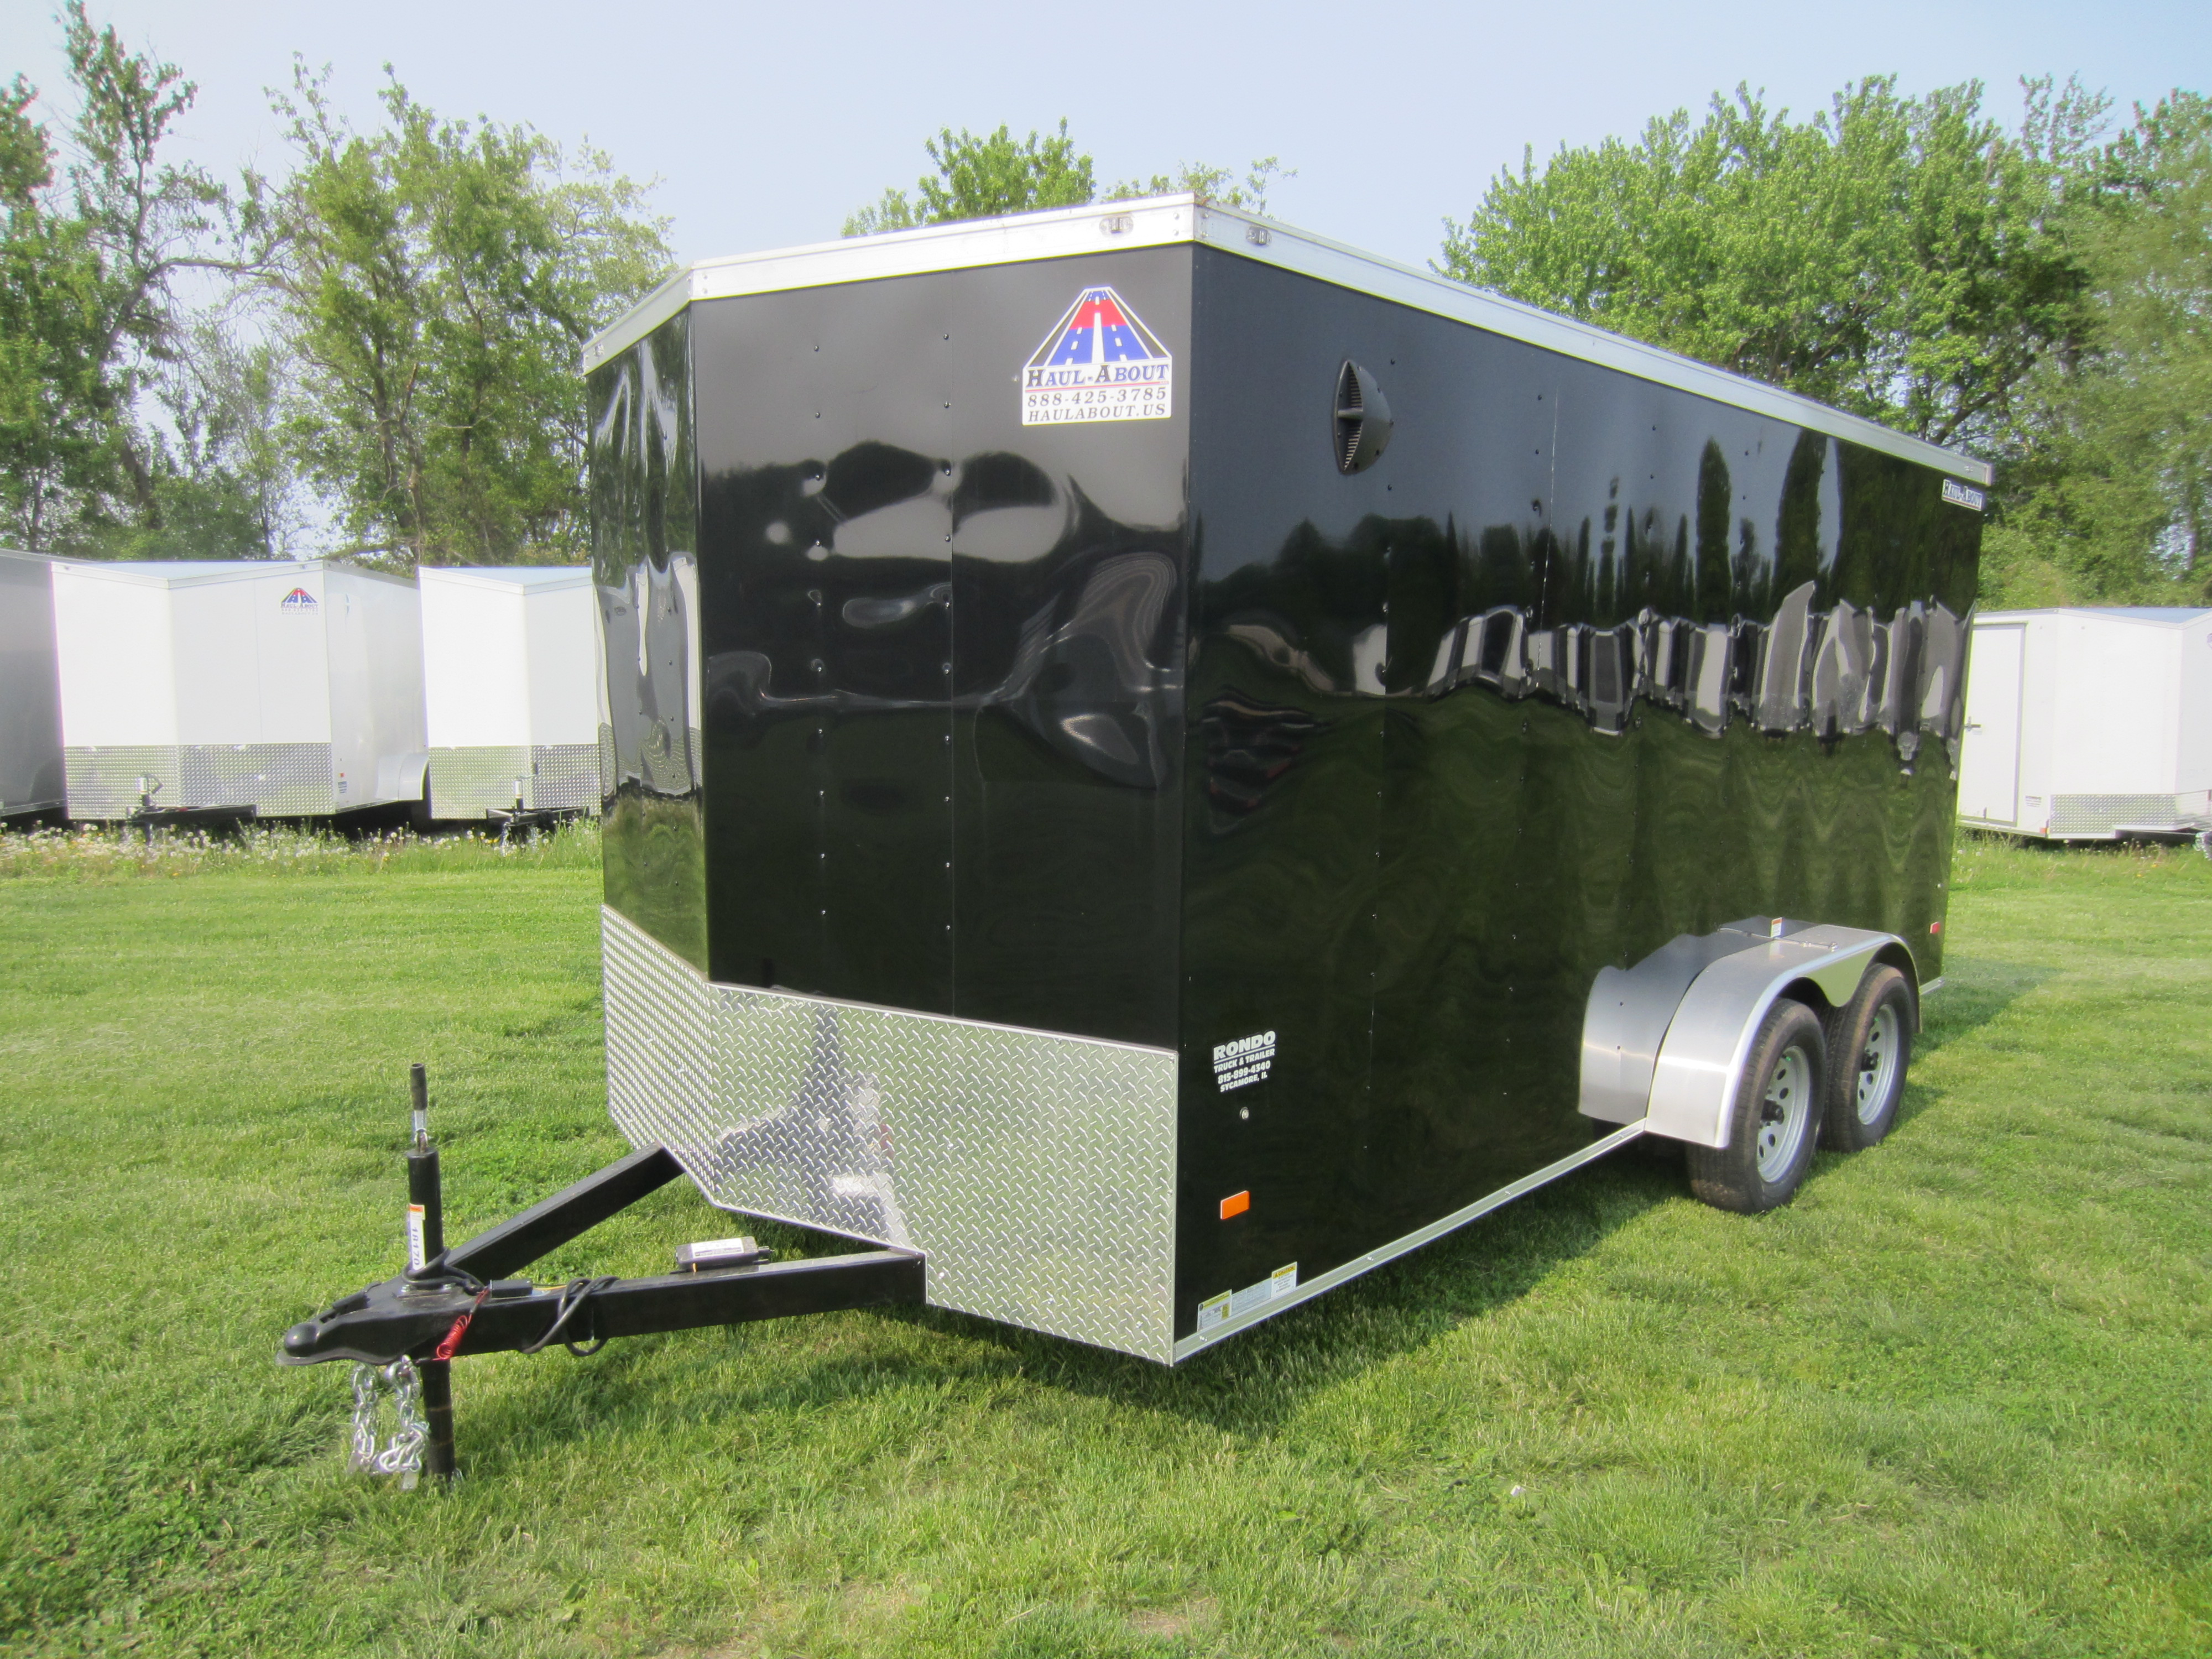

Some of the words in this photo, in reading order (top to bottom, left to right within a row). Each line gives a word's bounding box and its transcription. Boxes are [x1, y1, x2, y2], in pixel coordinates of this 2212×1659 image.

[1026, 364, 1170, 387] HAUL-ABOUT
[1027, 387, 1166, 408] 888-425-3785
[1027, 403, 1166, 422] HAULABOUT.US
[1213, 1031, 1276, 1061] RONDO
[1213, 1058, 1238, 1074] TRUCK
[1239, 1057, 1244, 1066] &
[1245, 1048, 1275, 1064] TRAILER
[1218, 1060, 1271, 1084] 815-899-4340
[1220, 1074, 1260, 1093] SYCAMORE,
[1261, 1071, 1268, 1079] IL
